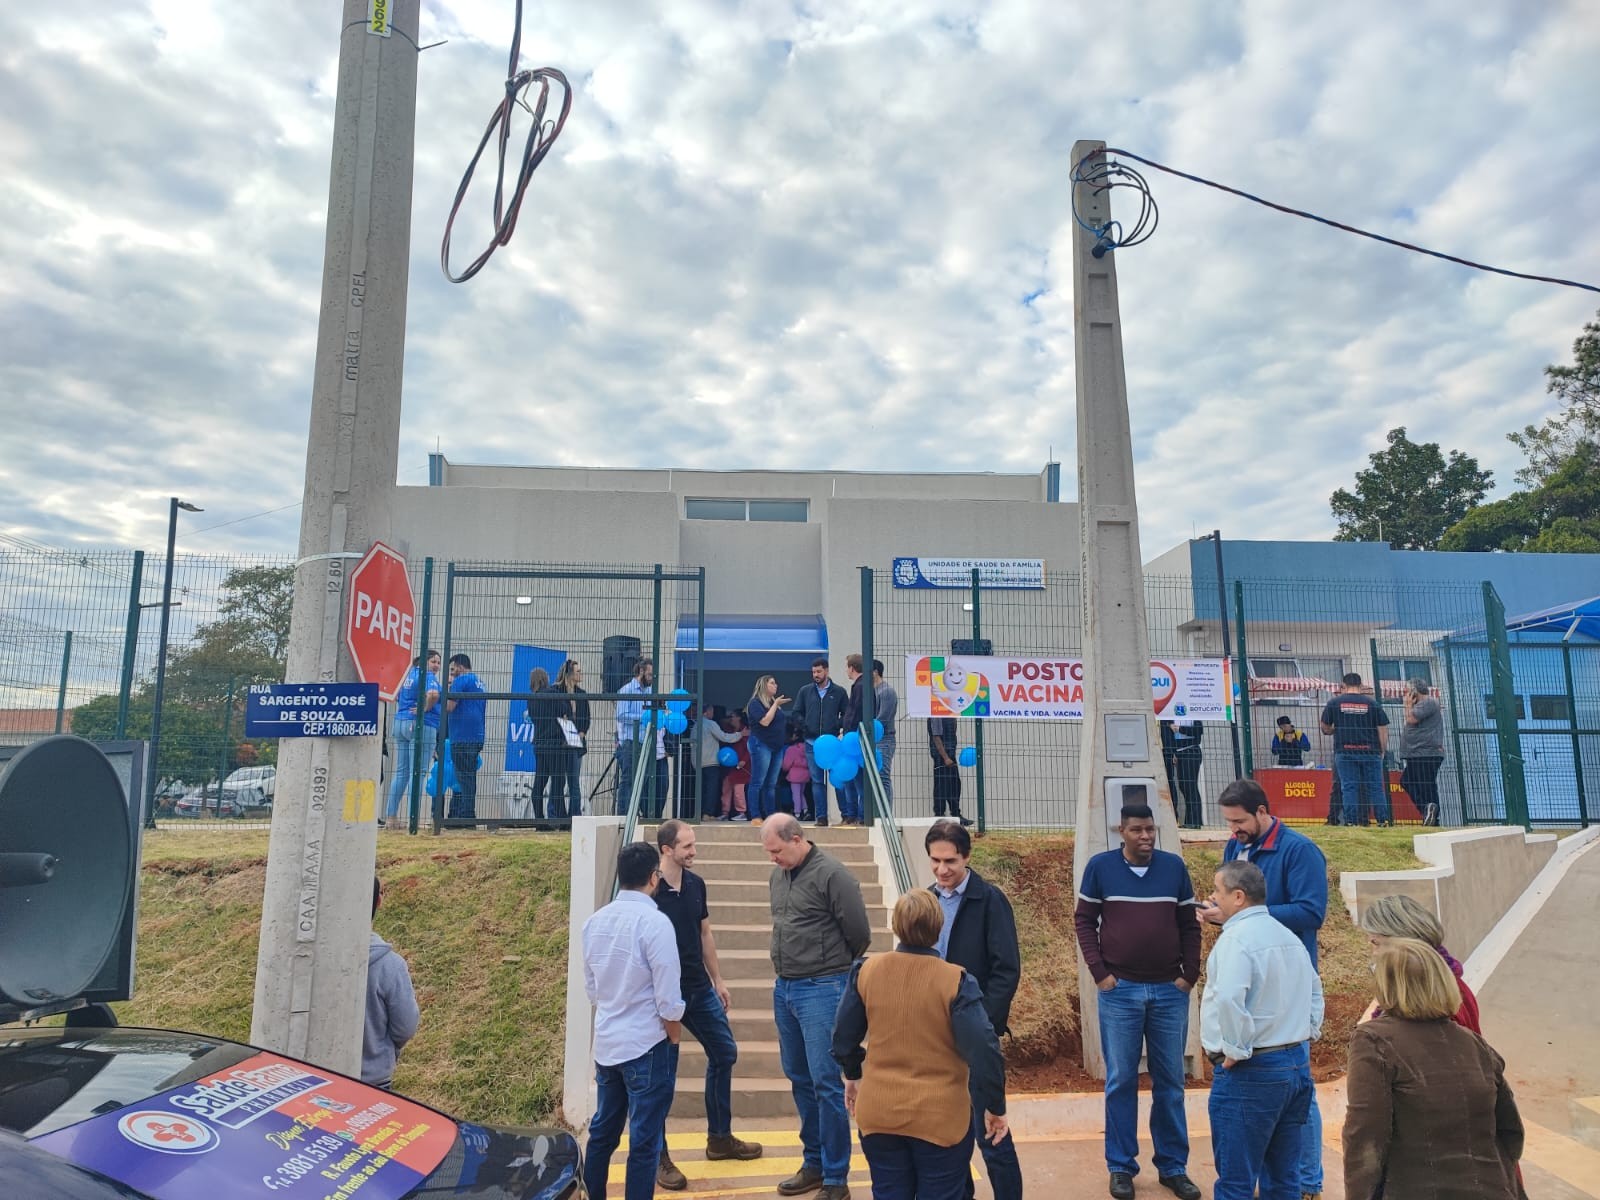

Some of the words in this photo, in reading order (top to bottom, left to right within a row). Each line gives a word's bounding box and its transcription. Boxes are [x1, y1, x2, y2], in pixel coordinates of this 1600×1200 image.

[329, 557, 342, 578] 60
[355, 591, 412, 650] PARE
[250, 684, 271, 694] RUA
[259, 695, 327, 706] SARGENTO
[331, 694, 366, 707] JOSÉ
[280, 711, 297, 721] DE
[300, 711, 345, 721] SOUZA
[303, 723, 377, 736] CEP.18608-044
[1285, 780, 1315, 789] ALGODÃO
[1284, 788, 1316, 798] DOCE
